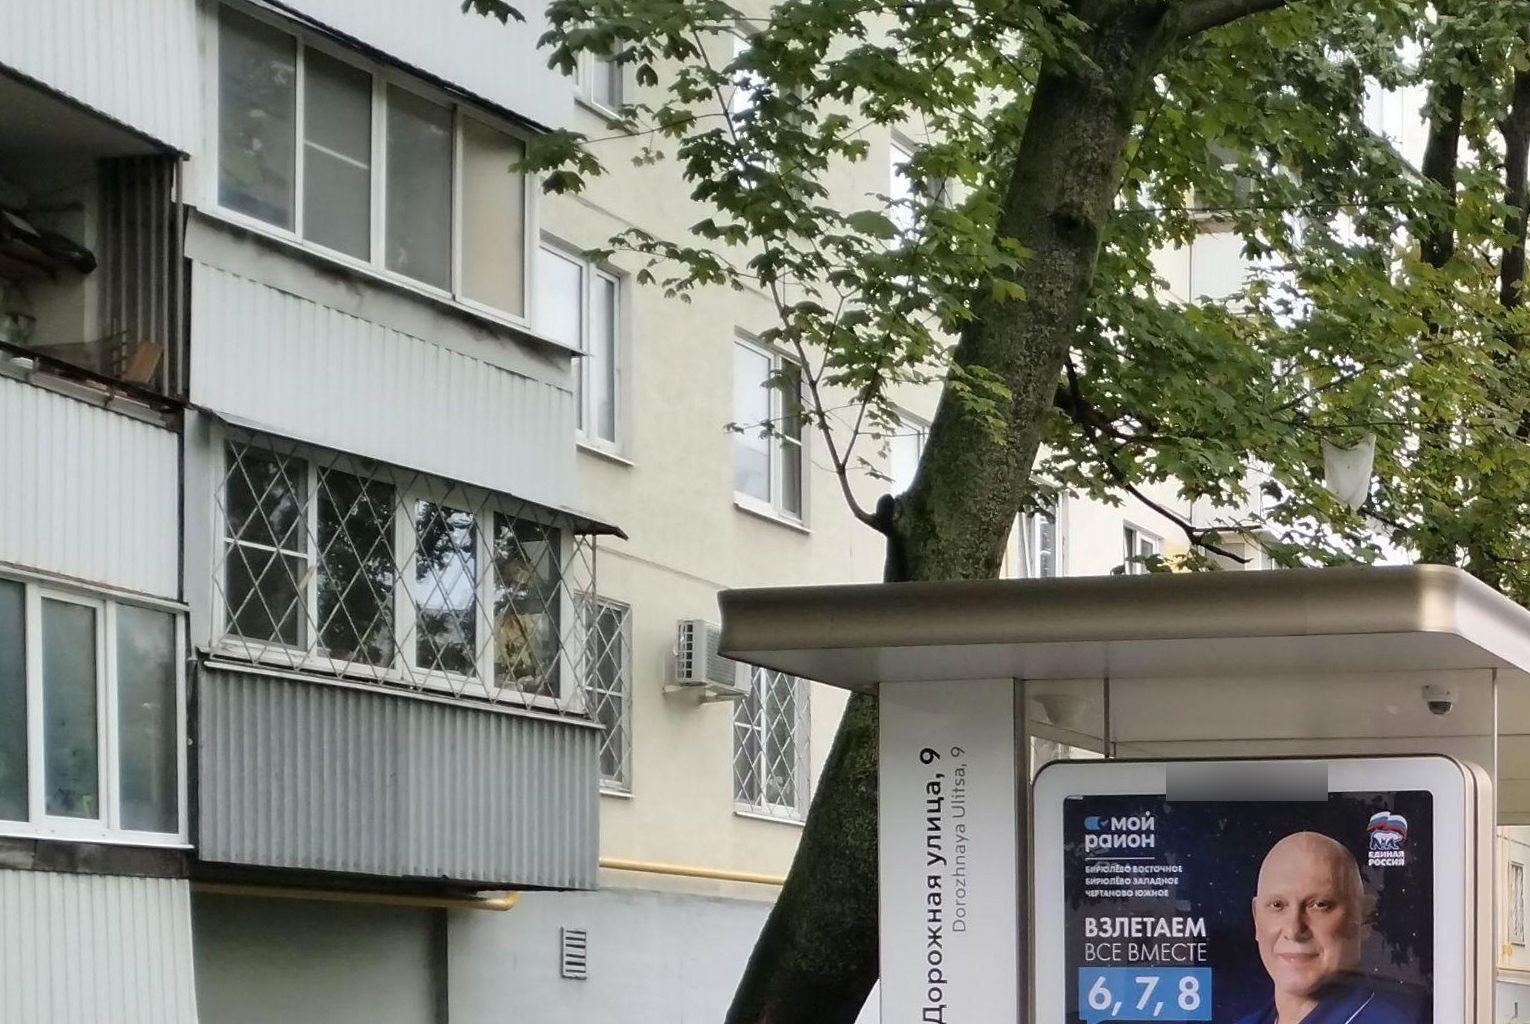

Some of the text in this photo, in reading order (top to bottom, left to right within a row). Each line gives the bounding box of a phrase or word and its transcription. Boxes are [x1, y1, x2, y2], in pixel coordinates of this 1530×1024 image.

[919, 747, 941, 765] 9
[926, 772, 947, 866] улица,
[950, 746, 970, 933] Dorozhnaya Ulitsa, 9
[1368, 850, 1405, 859] ЕДИНАЯ
[1368, 858, 1405, 866] РОССИЯ
[1133, 865, 1183, 873] ВОСТОЧНОЕ
[1133, 877, 1179, 886] ЗАПАДНОЕ
[1085, 889, 1169, 897] ЧЕРТАНОВО ЮЖНОЕ
[1085, 917, 1207, 938] ВЗЛЕТАЕМ
[1085, 943, 1207, 962] ВСЕ ВМЕСТЕ
[1088, 976, 1201, 1017] 6, 7, 8
